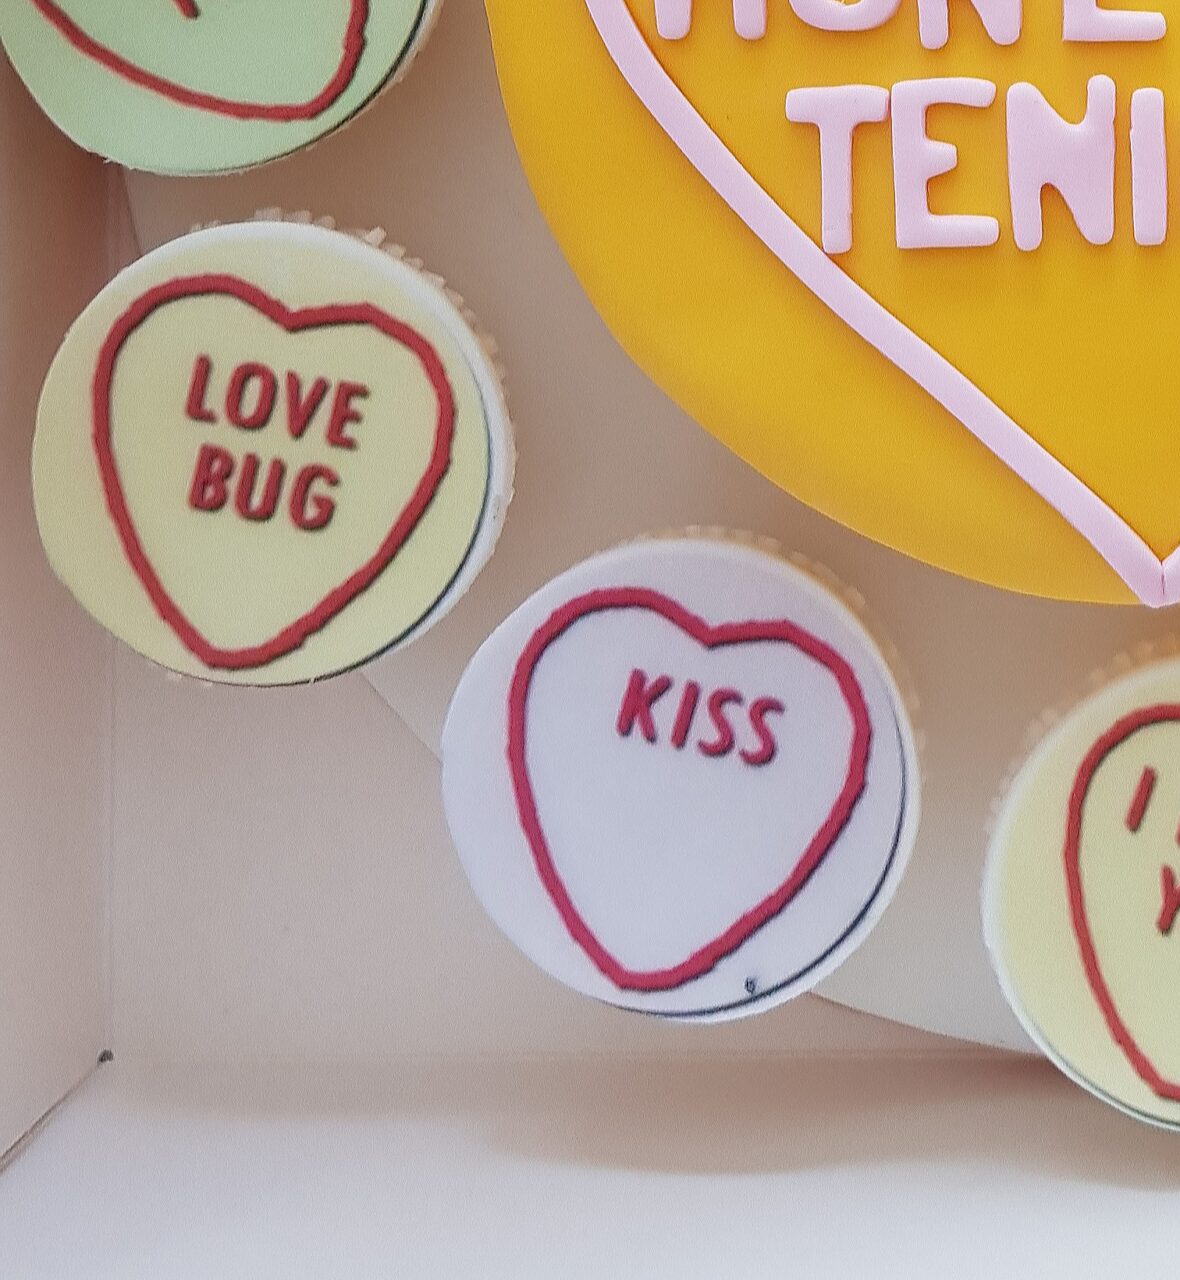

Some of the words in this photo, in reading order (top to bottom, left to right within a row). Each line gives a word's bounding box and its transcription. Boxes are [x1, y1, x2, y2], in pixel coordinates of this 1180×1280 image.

[185, 355, 370, 450] LOVE
[189, 444, 341, 532] BUG
[617, 669, 786, 767] KISS
[1126, 768, 1158, 834] I
